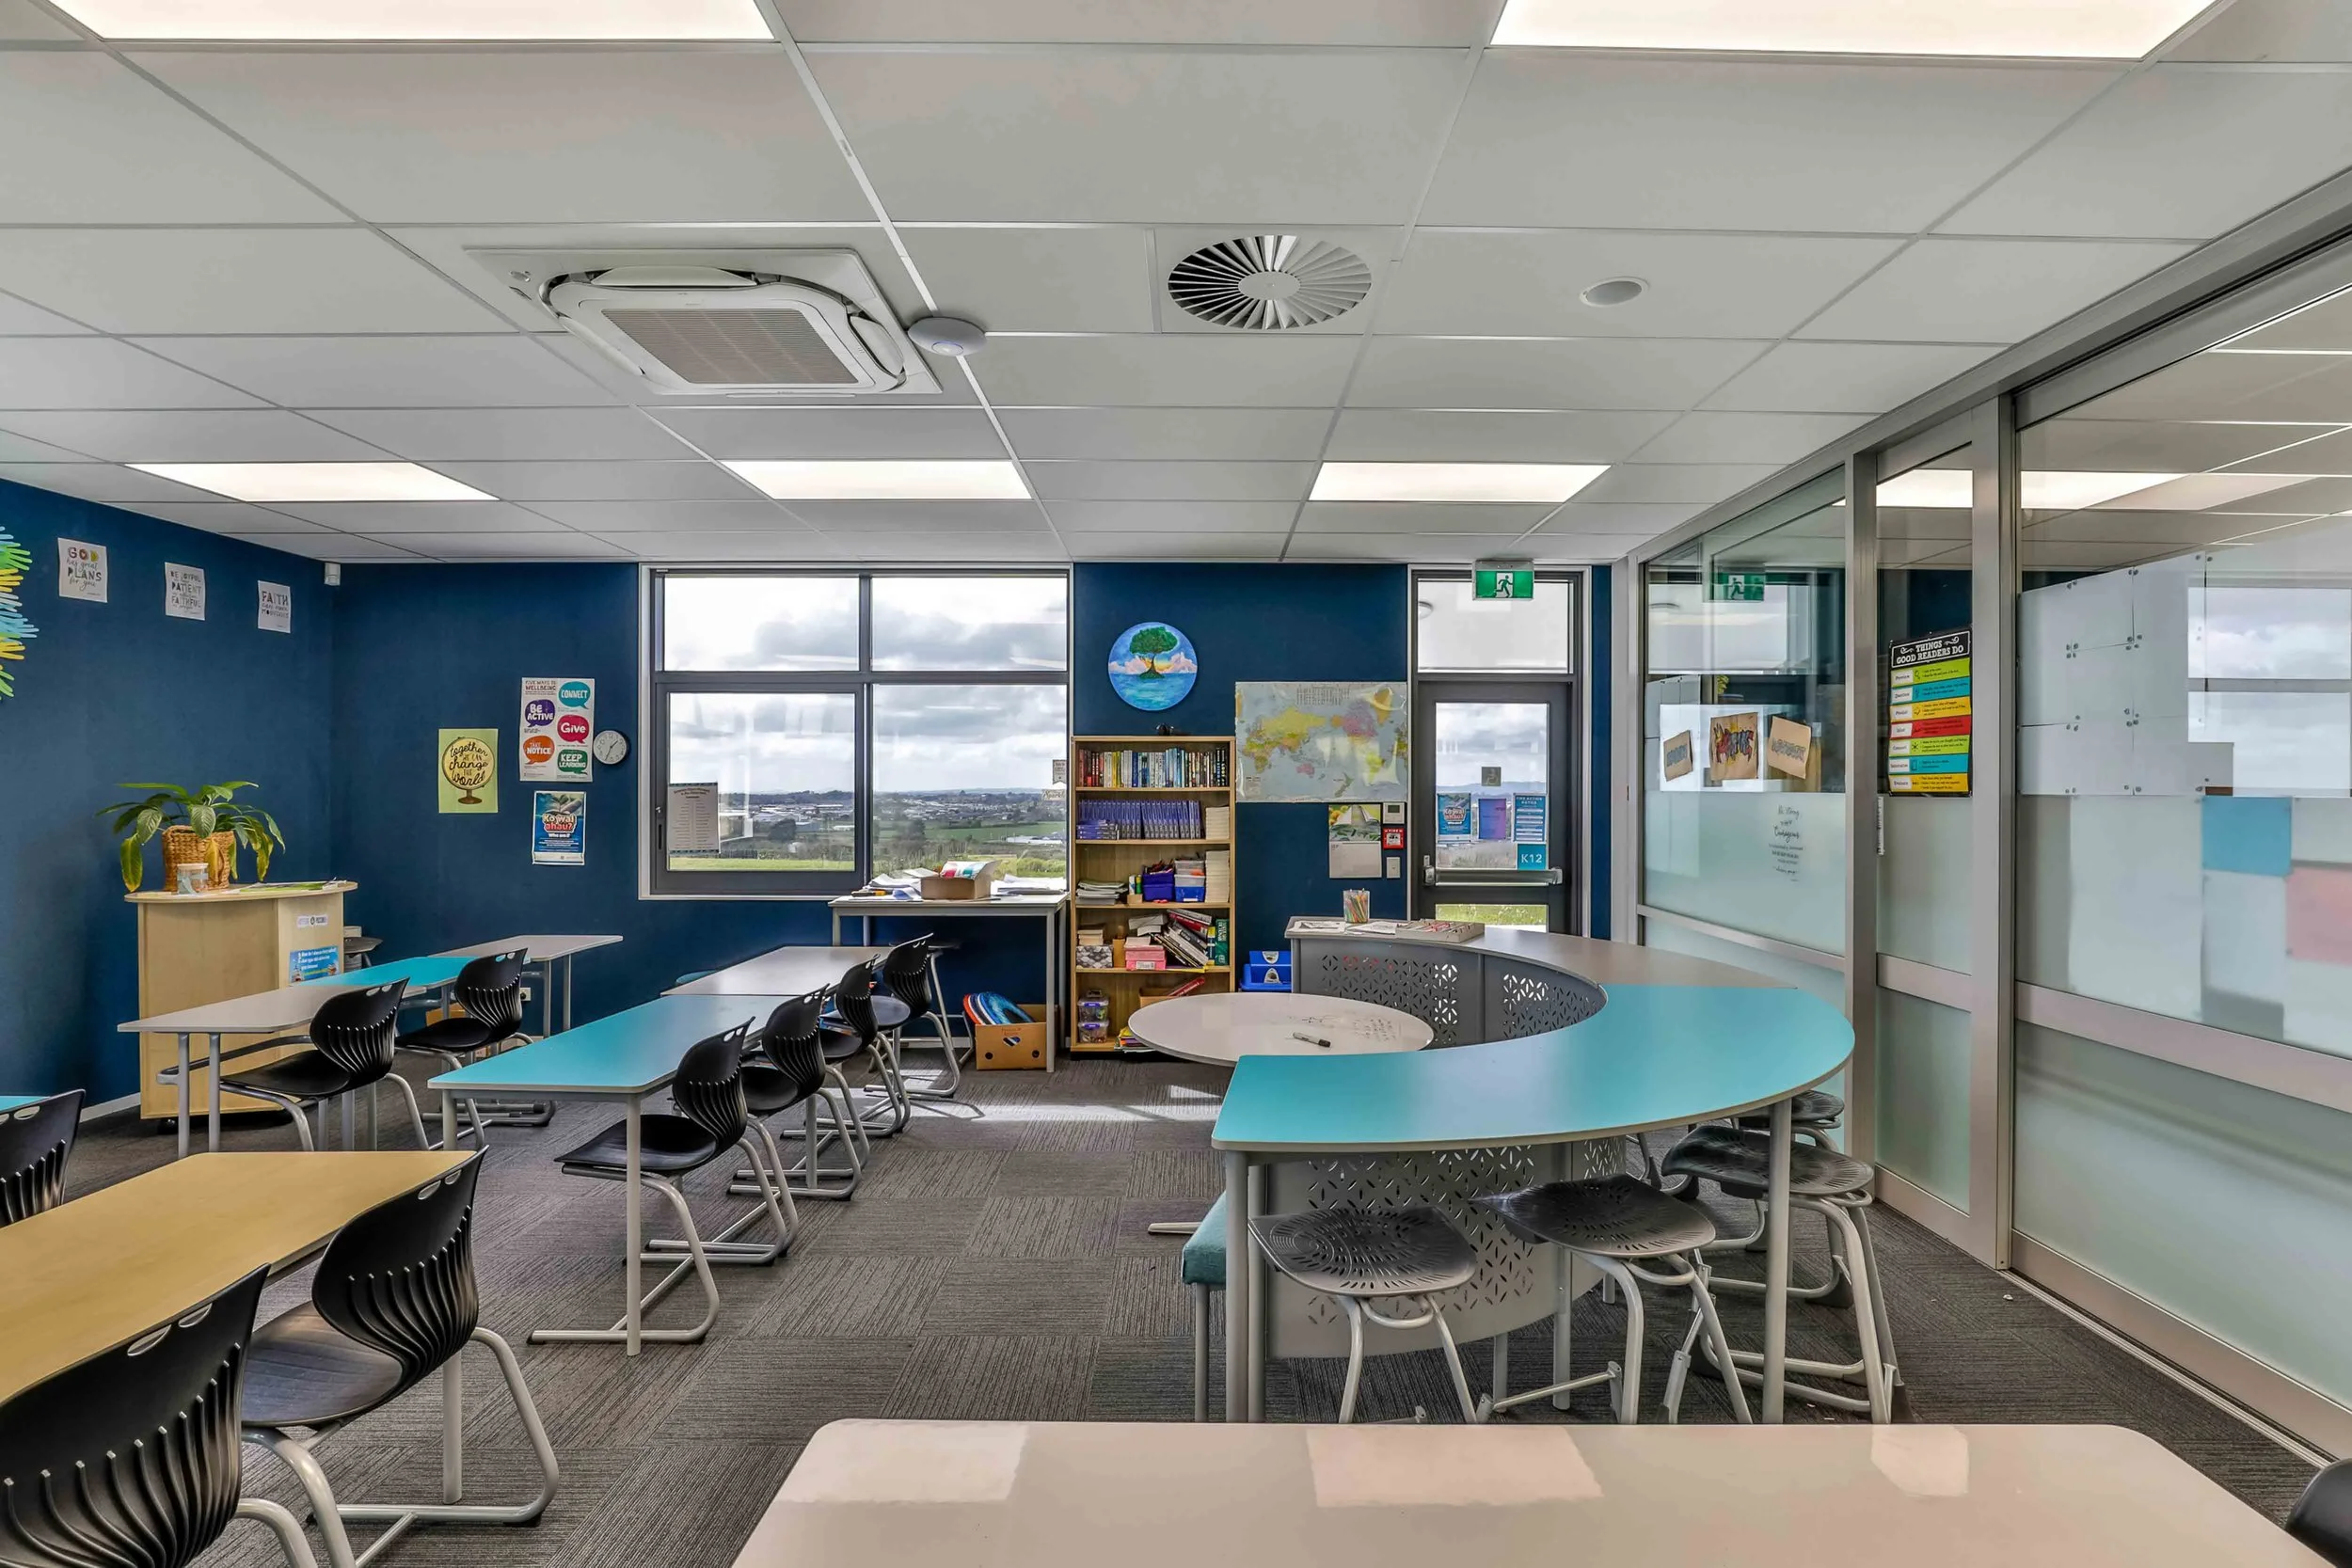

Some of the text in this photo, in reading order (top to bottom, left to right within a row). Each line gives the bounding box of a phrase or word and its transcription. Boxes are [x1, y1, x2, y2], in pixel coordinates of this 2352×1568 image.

[68, 566, 103, 581] PLANS
[262, 591, 289, 606] FAITH
[1915, 640, 1943, 653] THINGS
[1896, 644, 1964, 665] GOOD READERS DO
[562, 689, 588, 699] CONNECT
[530, 703, 543, 713] BE
[527, 712, 553, 721] ACTIVE
[561, 721, 586, 734] Give
[450, 741, 488, 758] together
[449, 755, 488, 771] change
[561, 753, 583, 762] KEEP
[452, 769, 485, 786] world
[545, 821, 573, 830] ahau?
[1521, 853, 1543, 863] K12
